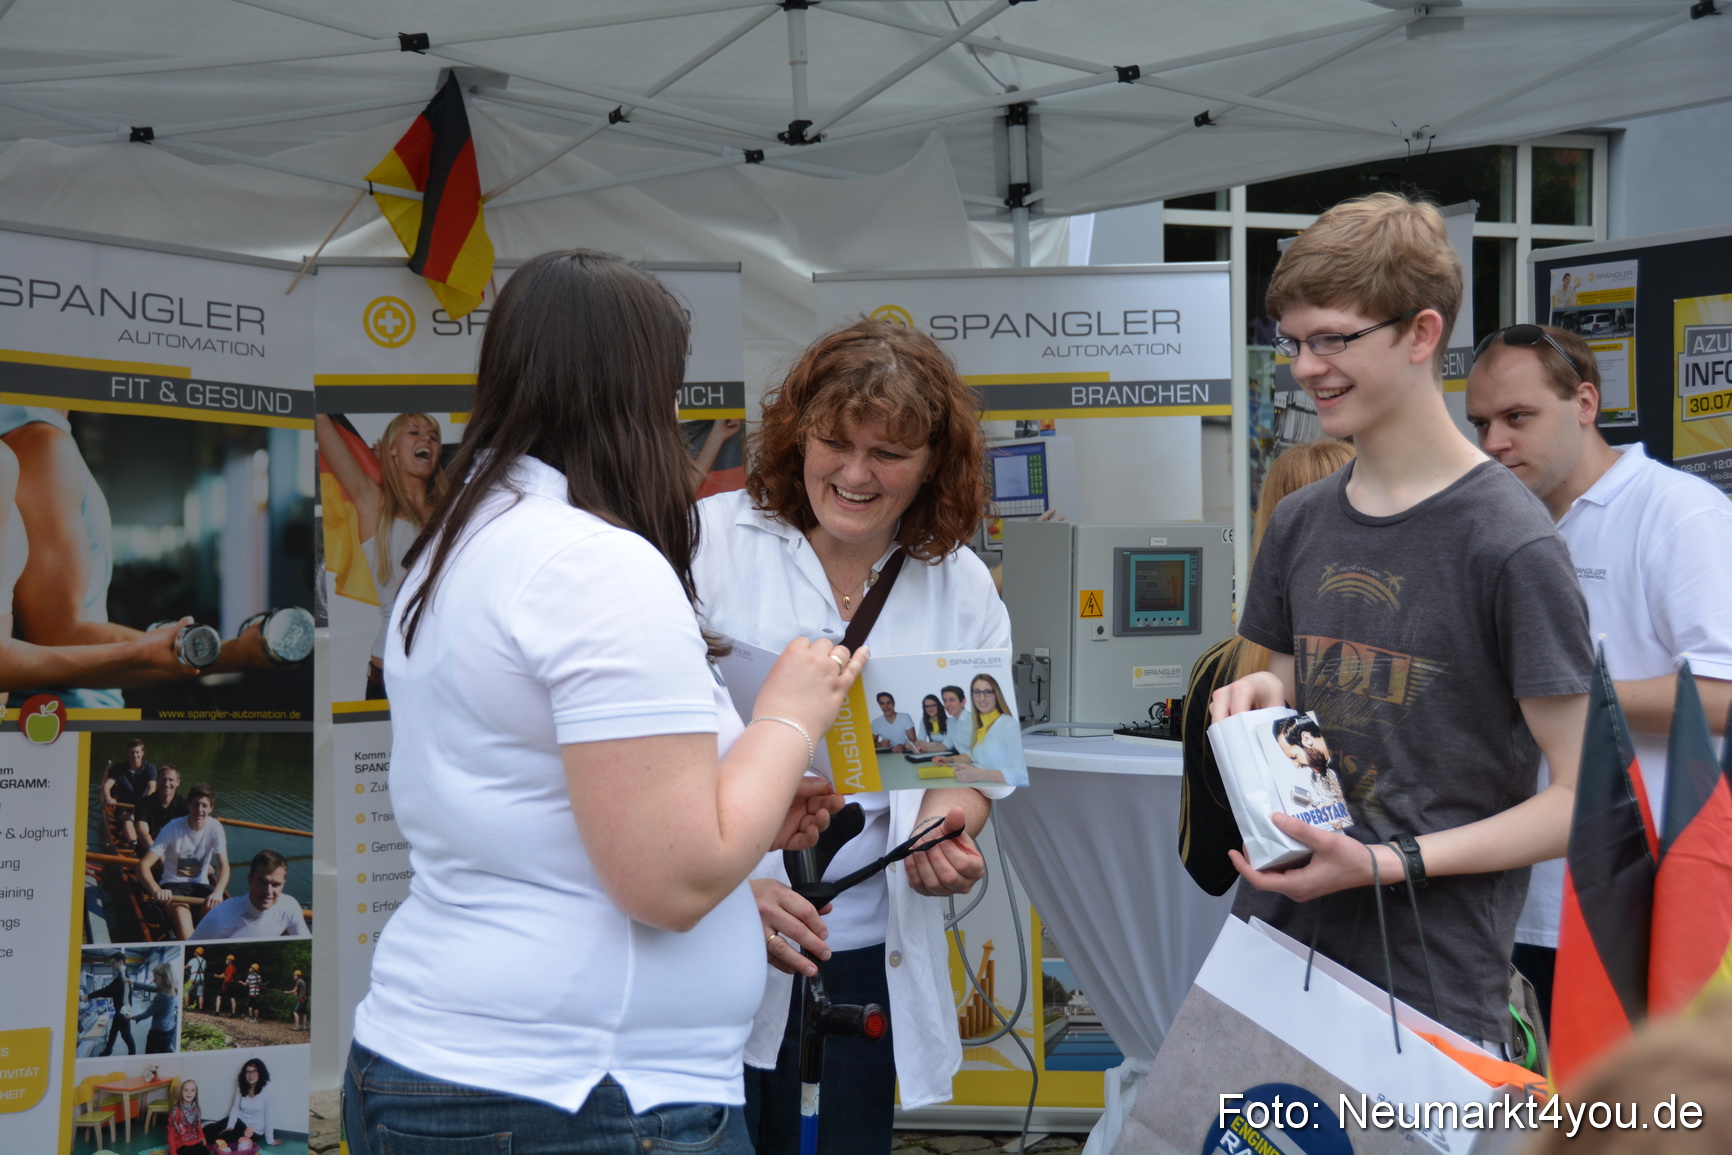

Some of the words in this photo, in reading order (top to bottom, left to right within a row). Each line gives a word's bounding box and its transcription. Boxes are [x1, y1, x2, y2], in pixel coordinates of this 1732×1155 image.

[0, 275, 265, 335] SPANGLER
[930, 309, 1181, 340] SPANGLER
[118, 329, 265, 358] AUTOMATION
[1042, 343, 1181, 358] AUTOMATION
[1692, 332, 1732, 354] AZU
[111, 376, 150, 399] FIT
[159, 380, 178, 403] &
[186, 383, 293, 414] GESUND
[1071, 383, 1210, 406] BRANCHEN
[949, 657, 1002, 666] SPANGLER
[1143, 668, 1181, 676] SPANGLER
[158, 709, 302, 720] www.spangler-automation.de
[354, 752, 387, 761] Komm
[1292, 802, 1348, 826] UPERSTAR
[5, 827, 16, 839] &
[19, 826, 69, 841] Joghurt
